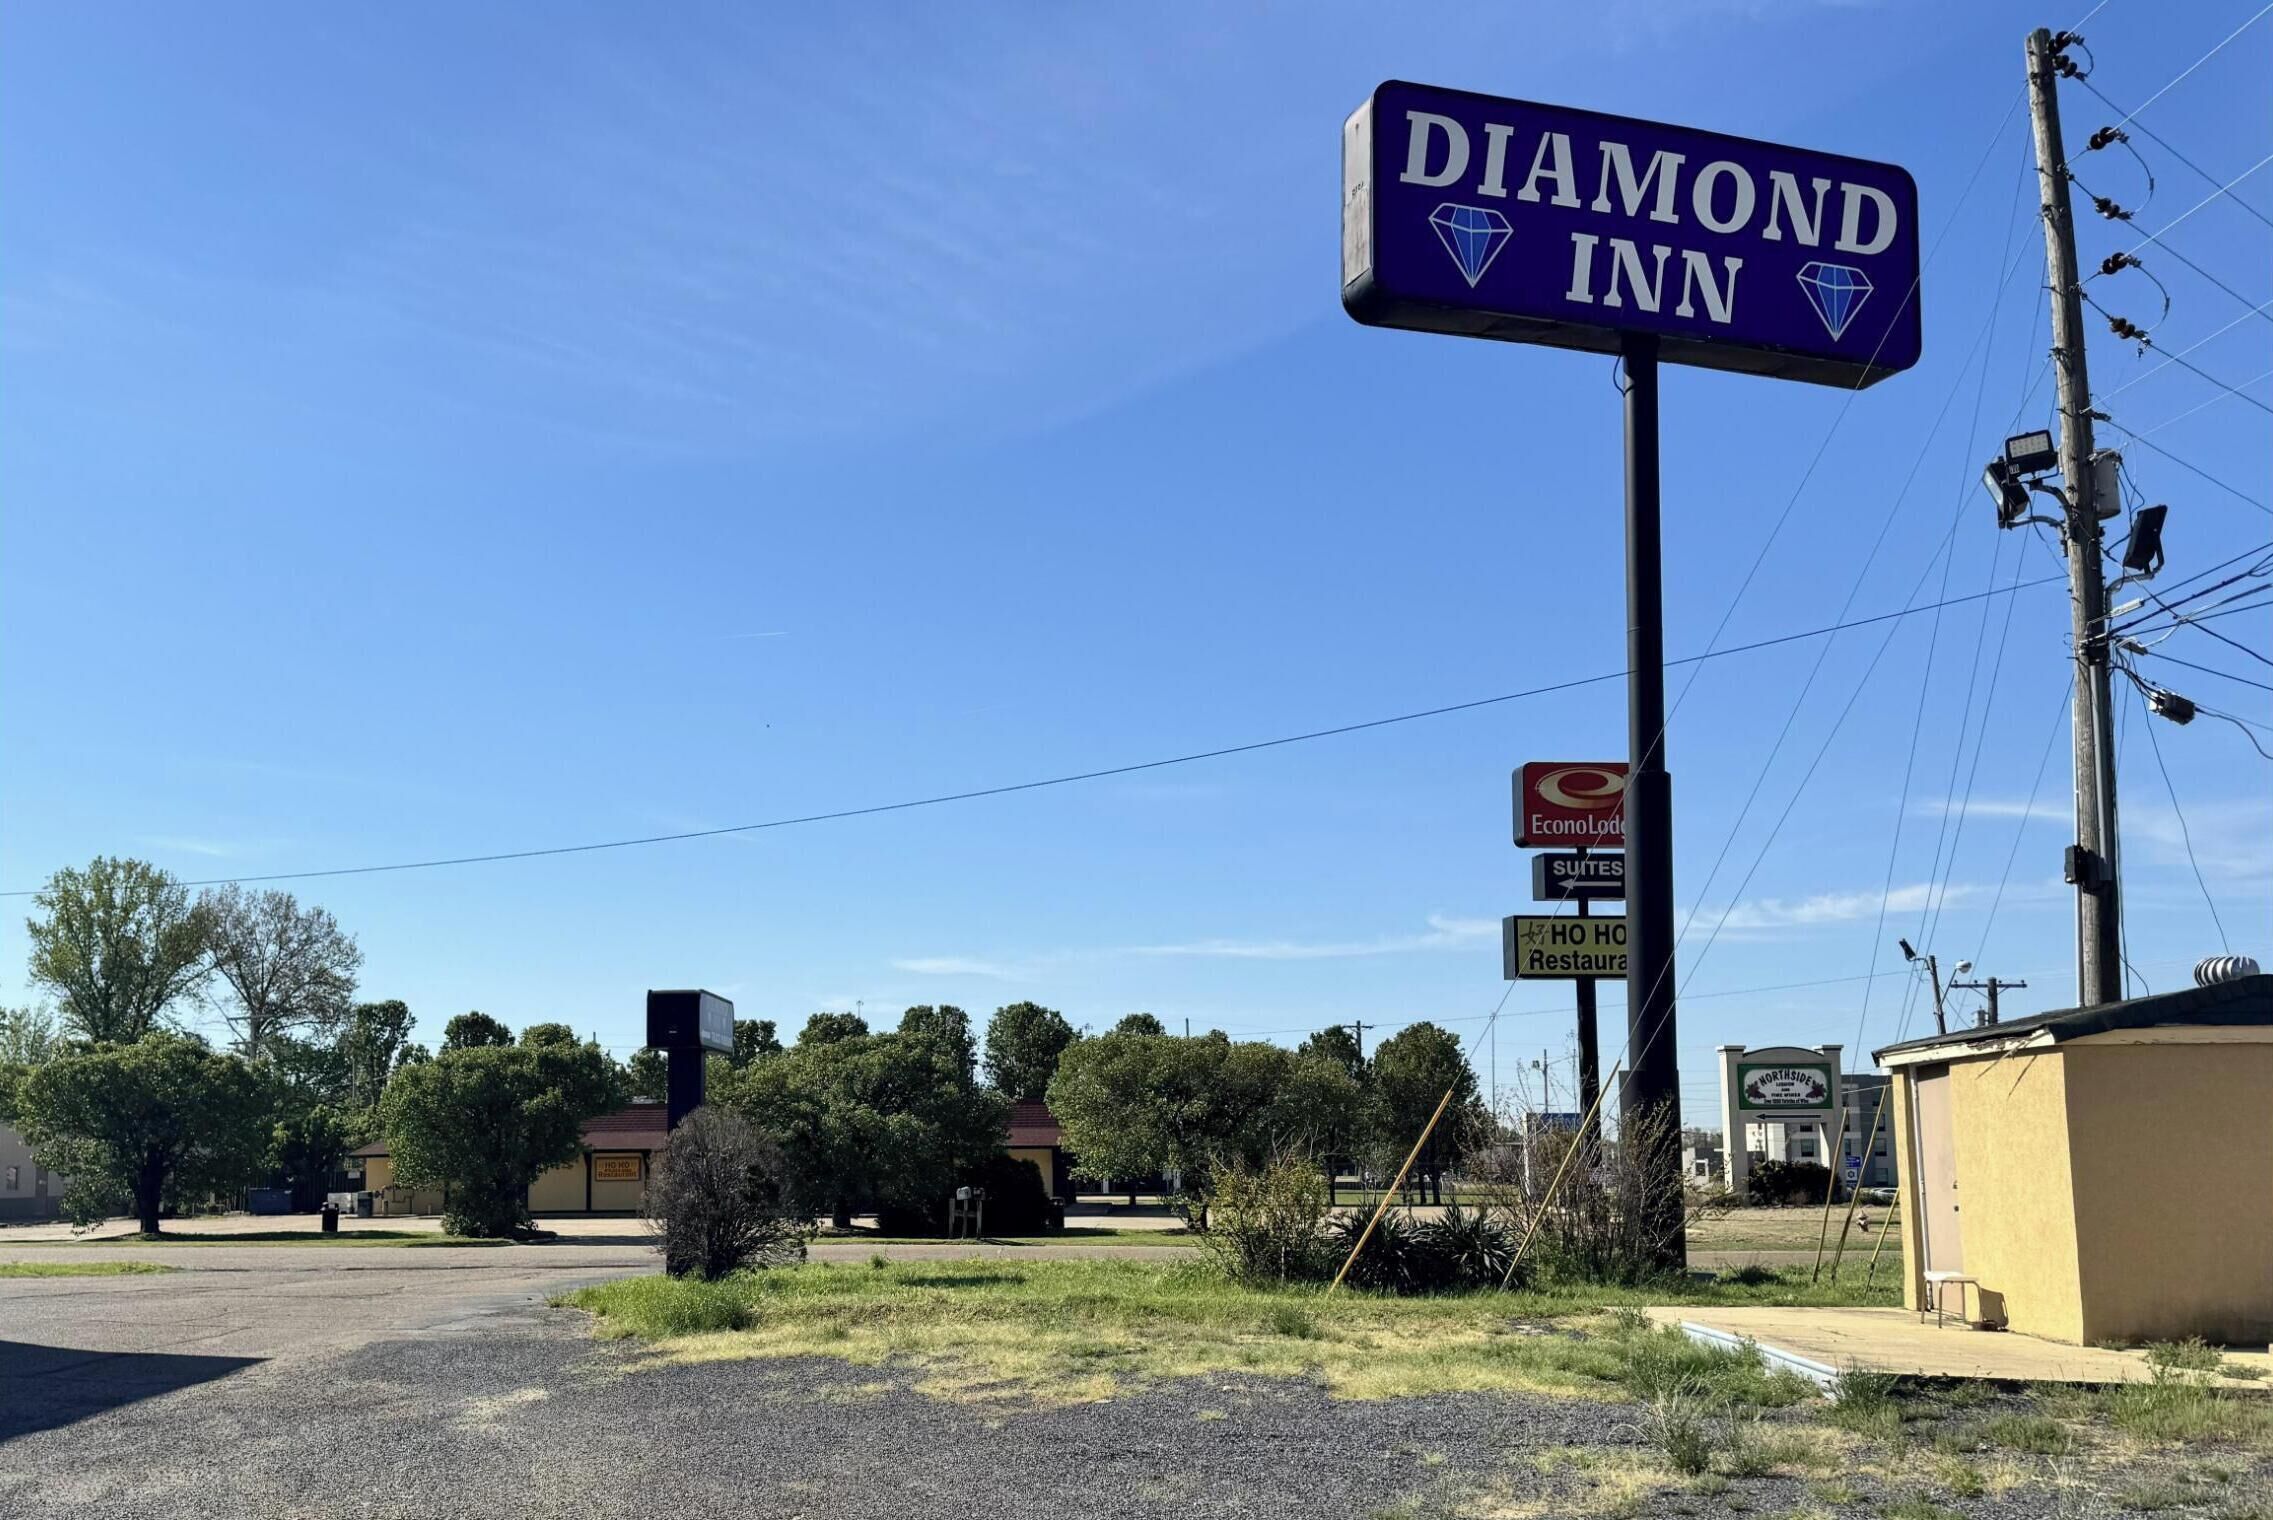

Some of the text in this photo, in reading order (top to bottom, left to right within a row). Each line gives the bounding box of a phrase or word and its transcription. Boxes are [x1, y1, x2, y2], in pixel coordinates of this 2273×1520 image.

[1400, 110, 1898, 256] DIAMOND
[1565, 232, 1744, 325] INN
[1553, 860, 1624, 876] SUITES
[1551, 923, 1627, 945] HO HO
[1759, 1068, 1812, 1086] NORTHSIDE
